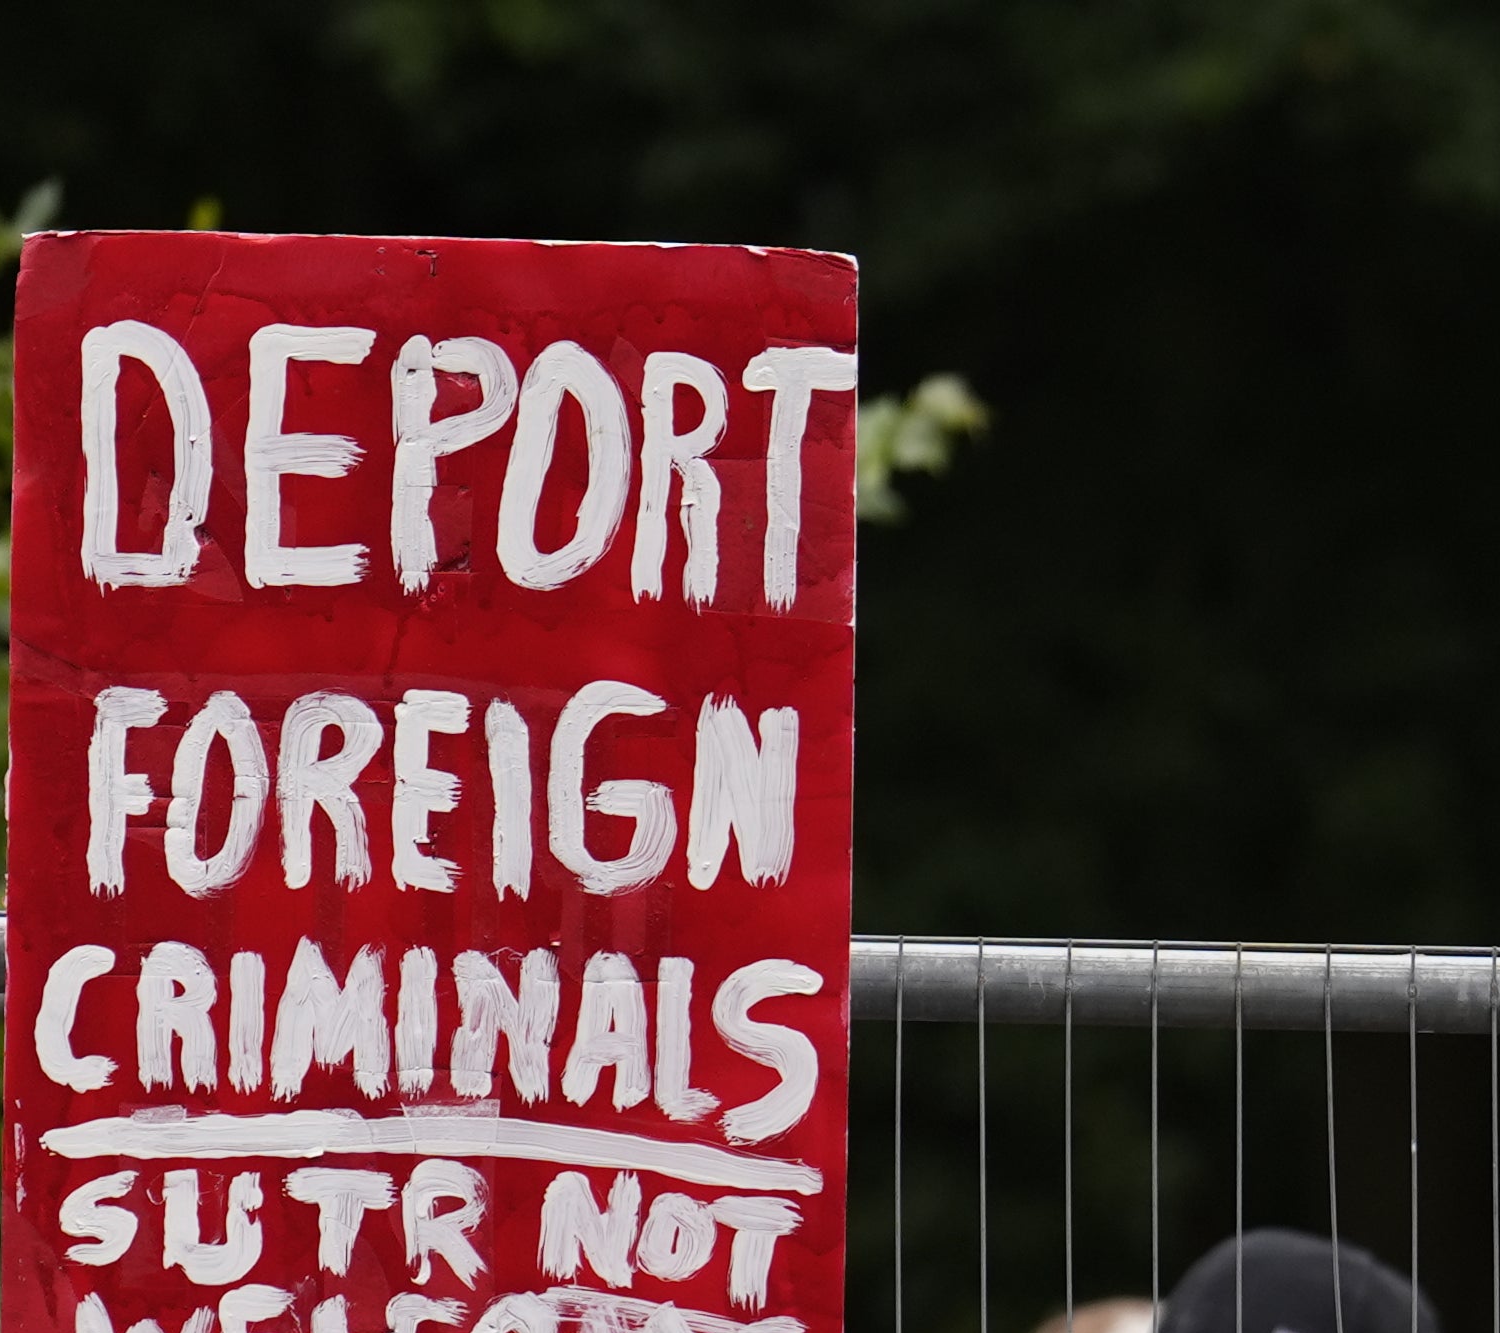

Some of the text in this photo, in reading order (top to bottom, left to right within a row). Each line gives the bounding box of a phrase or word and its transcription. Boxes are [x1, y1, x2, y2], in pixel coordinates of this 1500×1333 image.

[81, 320, 857, 612] DEPORT
[86, 681, 798, 901] FOREIGN
[35, 936, 822, 1144] CRIMINALS
[59, 1159, 802, 1312] SUTR NOT
